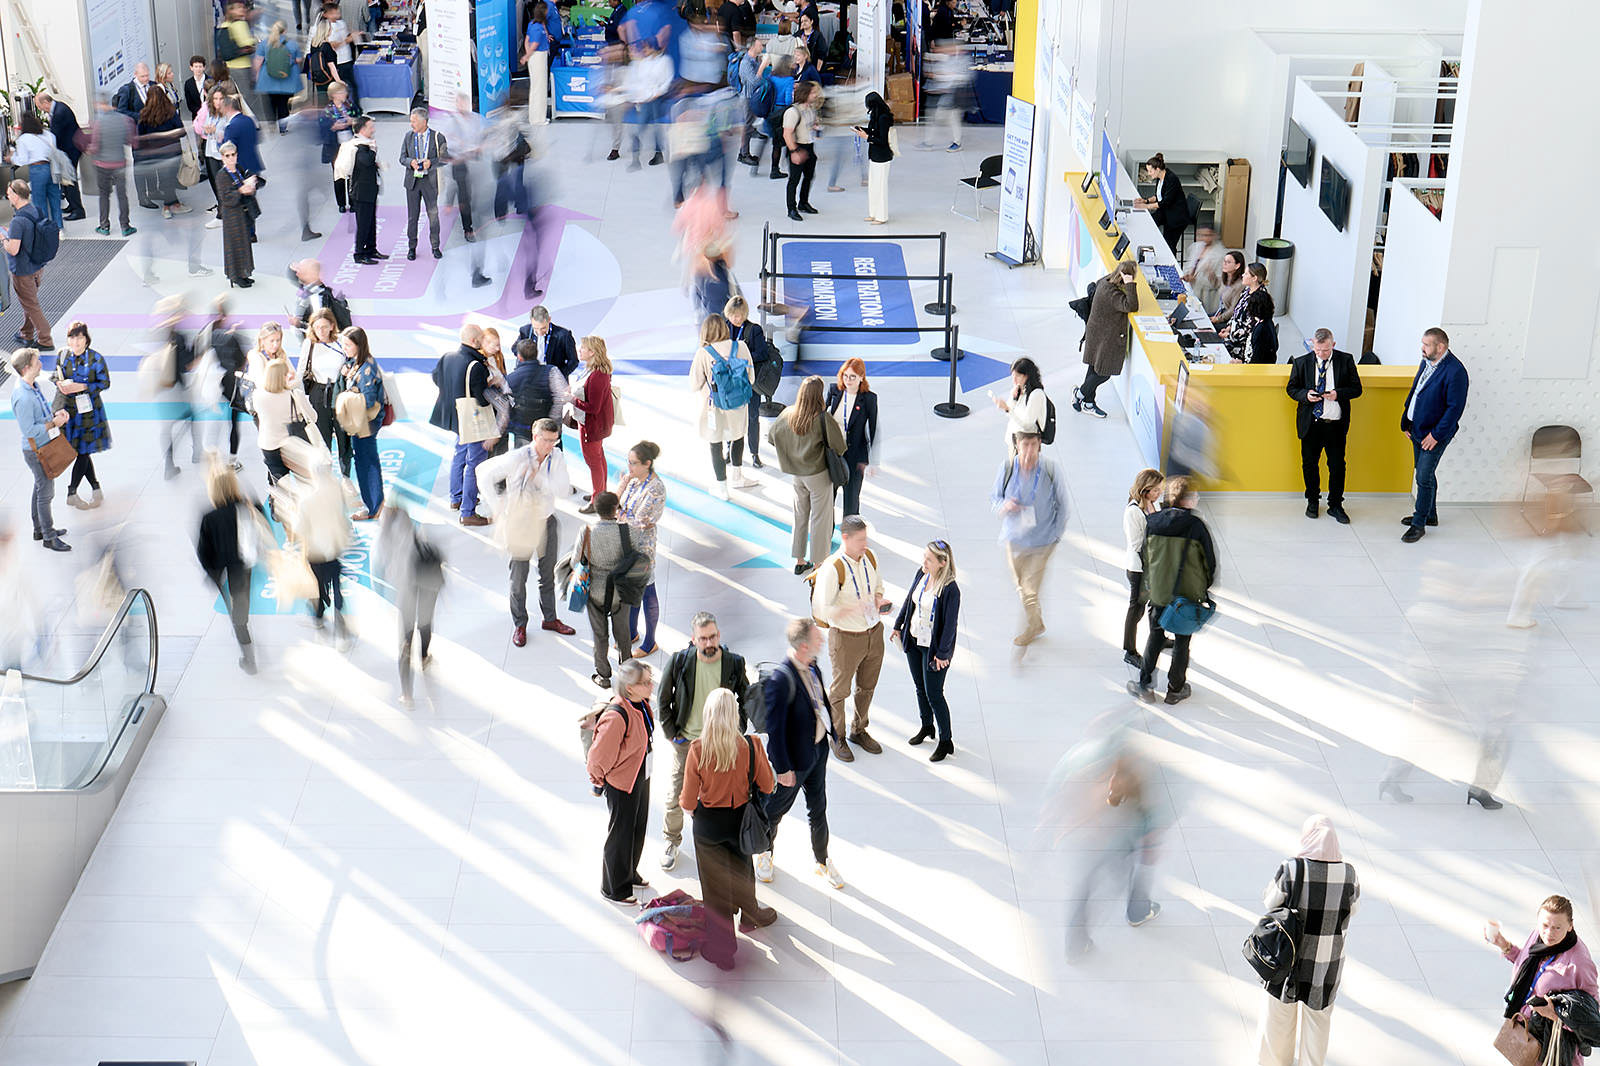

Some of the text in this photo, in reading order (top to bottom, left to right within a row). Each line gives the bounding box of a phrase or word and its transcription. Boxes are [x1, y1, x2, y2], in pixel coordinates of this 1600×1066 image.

[1021, 139, 1029, 147] APP
[332, 253, 362, 284] EAKS
[373, 263, 406, 293] LUNCH
[853, 257, 886, 327] REGITRATION &
